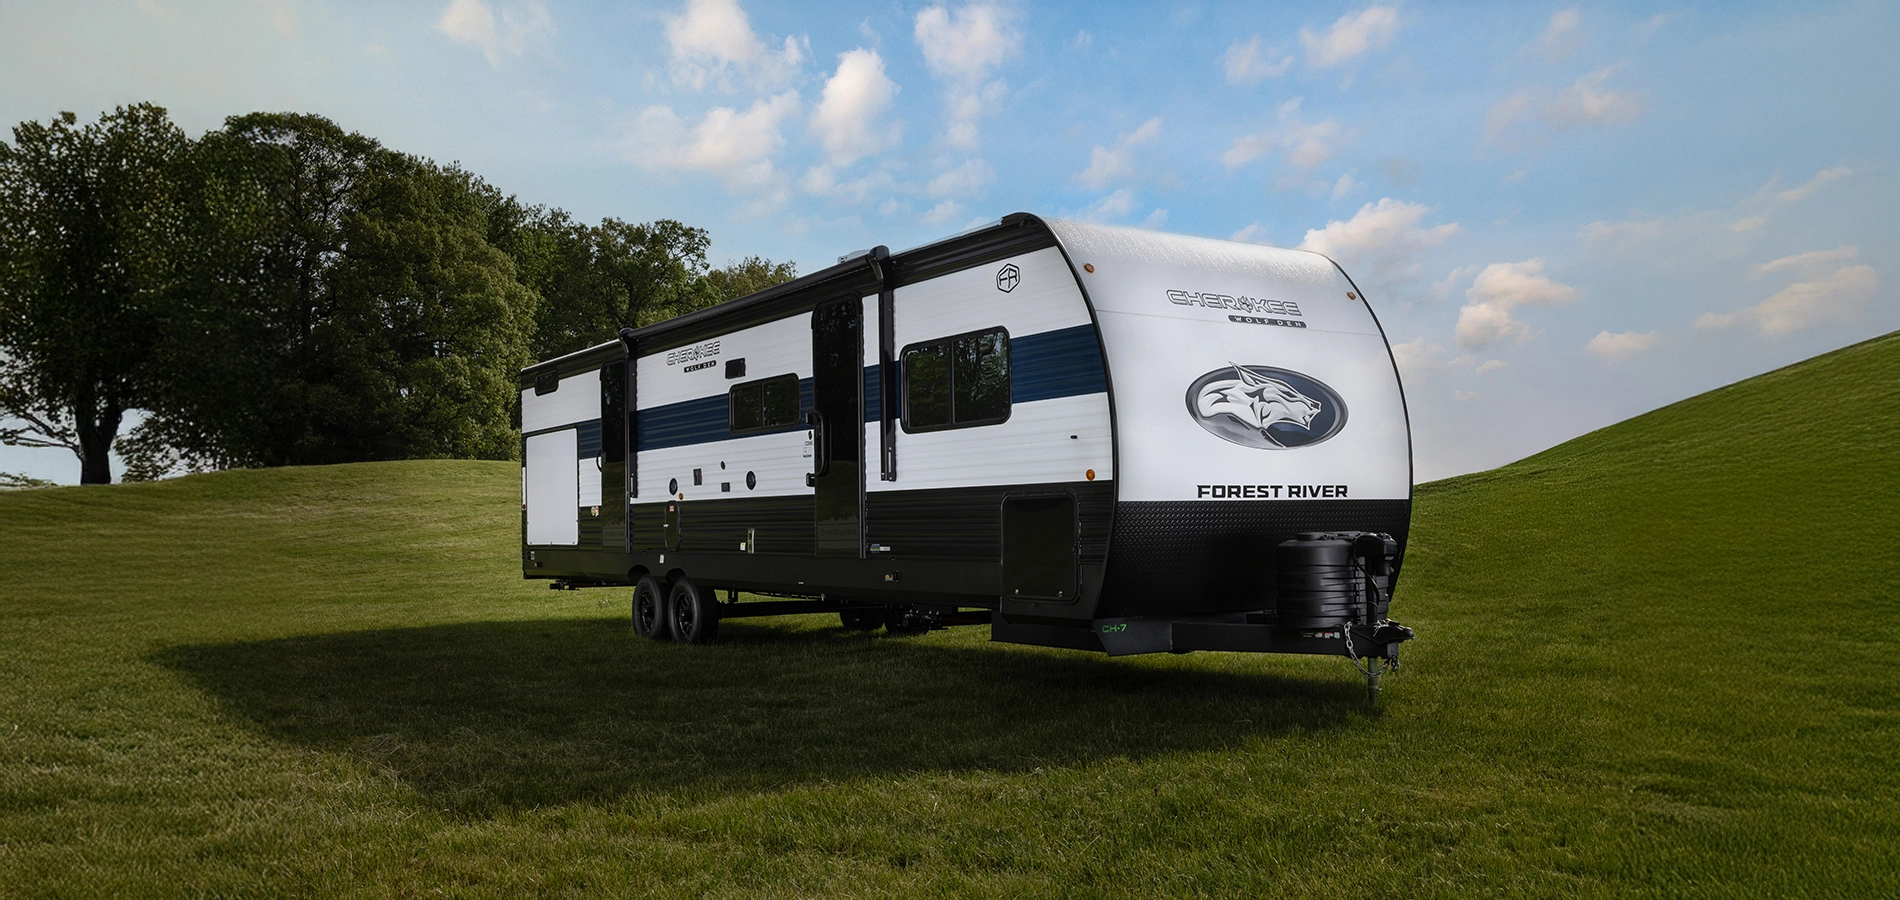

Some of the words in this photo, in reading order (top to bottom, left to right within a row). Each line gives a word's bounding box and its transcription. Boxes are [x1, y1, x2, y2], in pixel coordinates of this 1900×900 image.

[1166, 289, 1302, 316] CHEROKEE
[1234, 316, 1269, 325] WOLF
[1276, 319, 1302, 328] DEN
[1197, 485, 1283, 498] FOREST
[1288, 485, 1348, 498] RIVER
